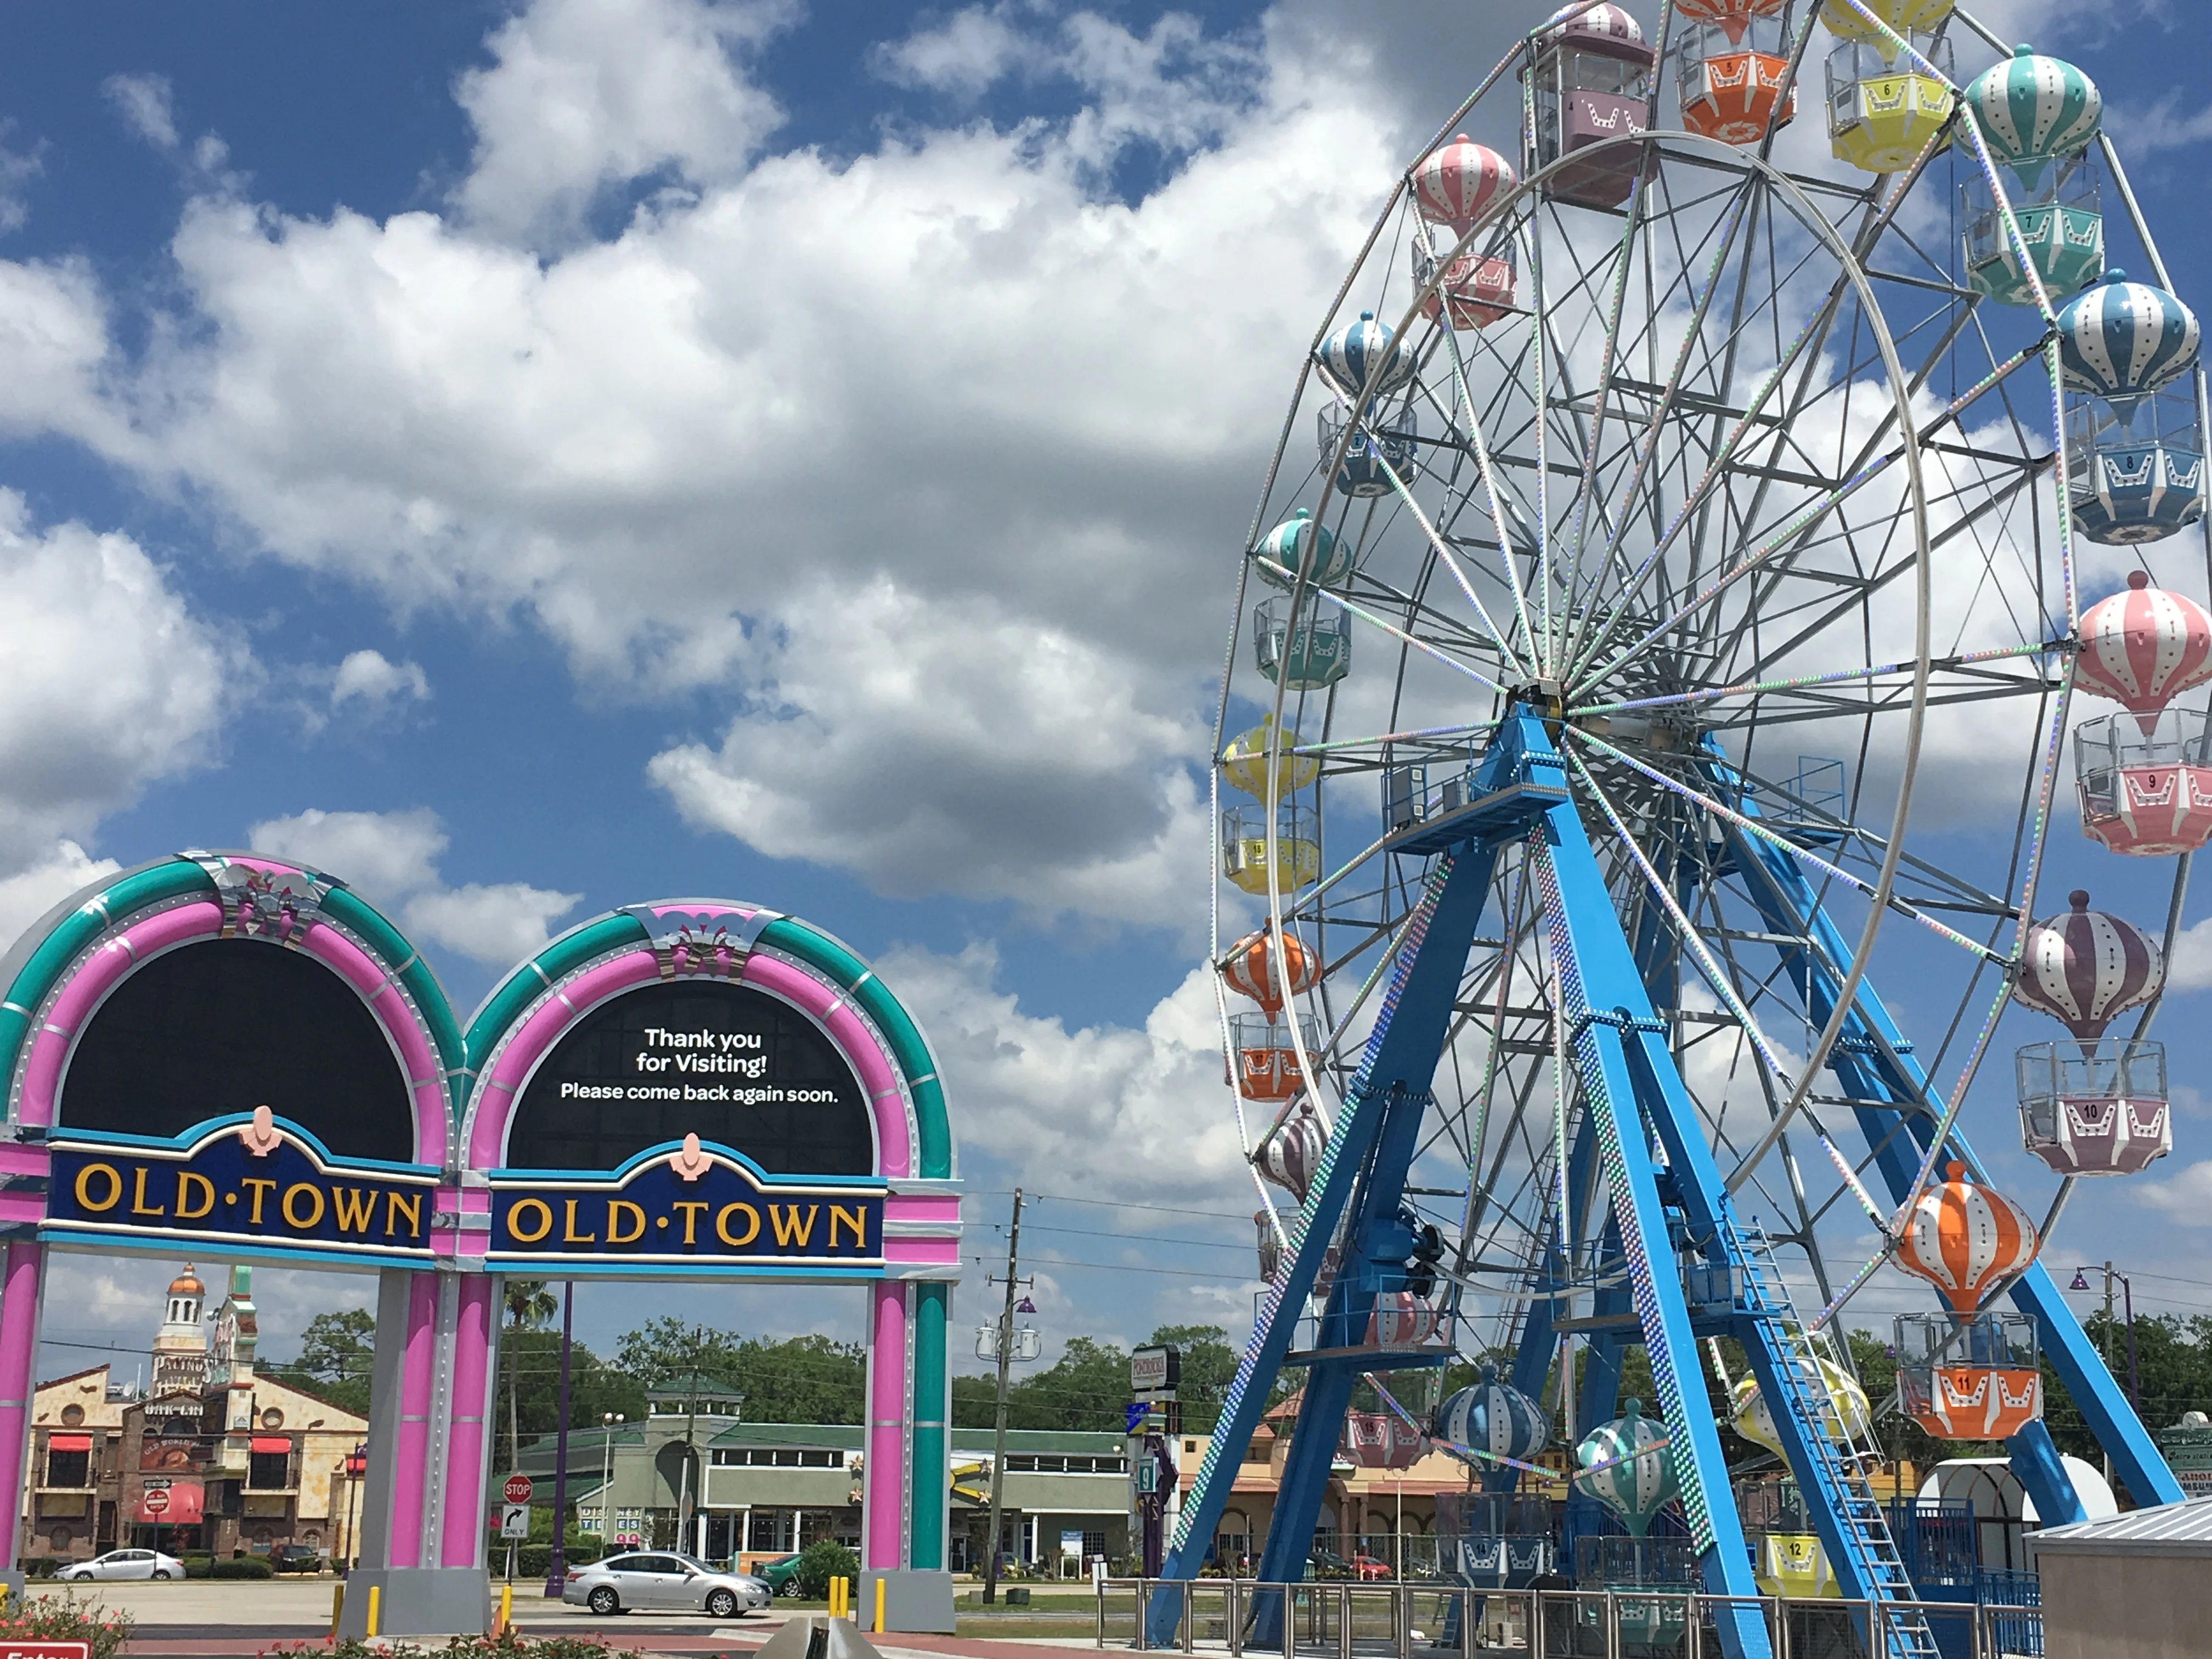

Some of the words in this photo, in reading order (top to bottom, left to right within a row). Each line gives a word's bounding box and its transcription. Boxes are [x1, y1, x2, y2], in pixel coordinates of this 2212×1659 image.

[1726, 62, 1733, 72] 5
[1884, 84, 1891, 95] 6
[1568, 101, 1573, 111] 4
[2025, 215, 2033, 228] 7
[1355, 437, 1359, 446] 2
[2126, 456, 2134, 469] 8
[2149, 774, 2156, 788] 9
[645, 1028, 715, 1048] Thank
[719, 1034, 761, 1052] you
[636, 1052, 672, 1071] for
[675, 1053, 767, 1079] Visiting!
[561, 1082, 624, 1099] Please
[627, 1087, 681, 1100] come
[684, 1084, 730, 1101] back
[732, 1085, 784, 1105] again
[787, 1090, 838, 1103] soon.
[2084, 1104, 2098, 1119] 10
[1958, 1376, 1970, 1391] 11
[1143, 1468, 1149, 1489] 9
[506, 1483, 531, 1495] STOP
[1477, 1543, 1486, 1554] 14
[1789, 1543, 1801, 1556] 12
